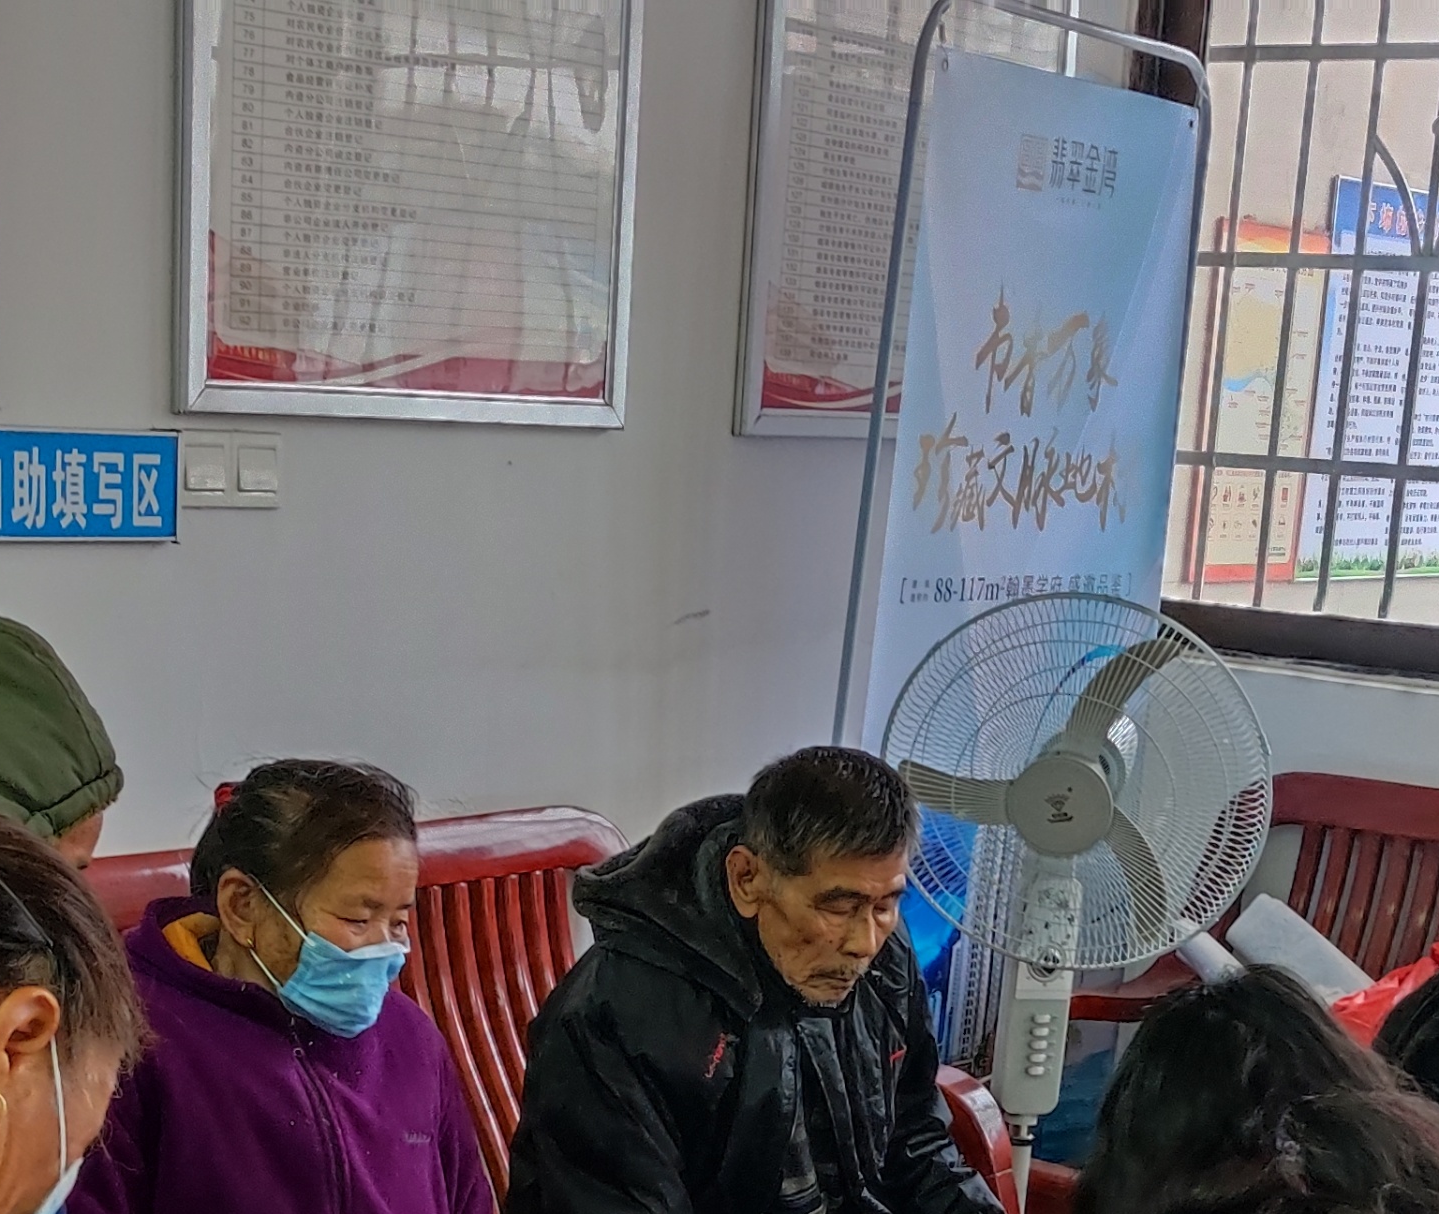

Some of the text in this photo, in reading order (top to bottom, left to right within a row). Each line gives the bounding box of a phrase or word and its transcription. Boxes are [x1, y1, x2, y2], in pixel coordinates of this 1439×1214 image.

[243, 11, 255, 22] 75
[1049, 135, 1118, 199] 翡翠金湾
